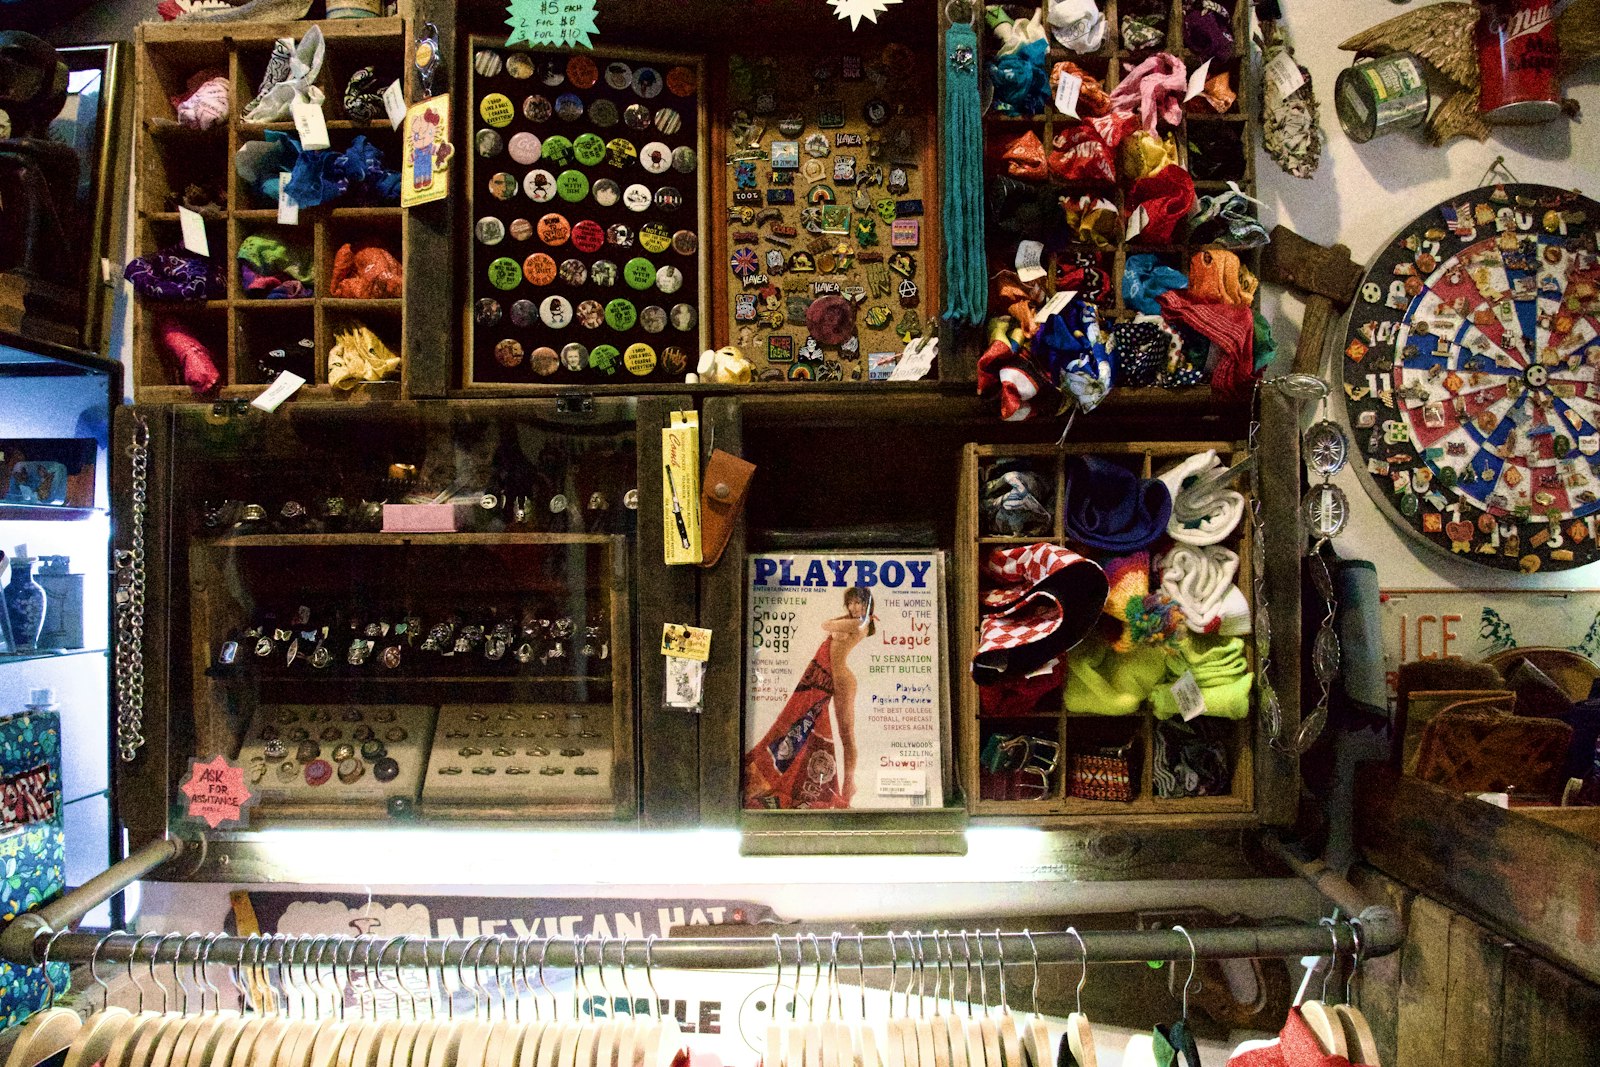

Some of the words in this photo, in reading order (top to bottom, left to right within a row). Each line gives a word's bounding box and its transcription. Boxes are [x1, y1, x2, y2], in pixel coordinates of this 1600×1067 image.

[521, 18, 528, 27] 2
[518, 31, 526, 40] 3
[561, 29, 581, 40] $10
[669, 433, 681, 468] Comb
[753, 559, 932, 588] PLAYBOY
[753, 597, 807, 605] INTERVIEW
[753, 605, 796, 623] Snoop
[902, 610, 912, 618] OF
[753, 620, 798, 639] Doggy
[911, 617, 931, 636] Ivy
[752, 632, 790, 653] Dogg
[883, 631, 931, 649] League
[1401, 613, 1462, 662] ICE
[871, 655, 880, 663] TV
[883, 655, 932, 663] SENSATION
[869, 666, 896, 674] BRETT
[900, 666, 932, 674] BUTLER
[896, 683, 931, 694] Playboy's
[902, 695, 931, 703] Preview
[880, 756, 933, 770] Showgirls
[197, 768, 224, 783] ASK
[208, 785, 228, 795] FOR
